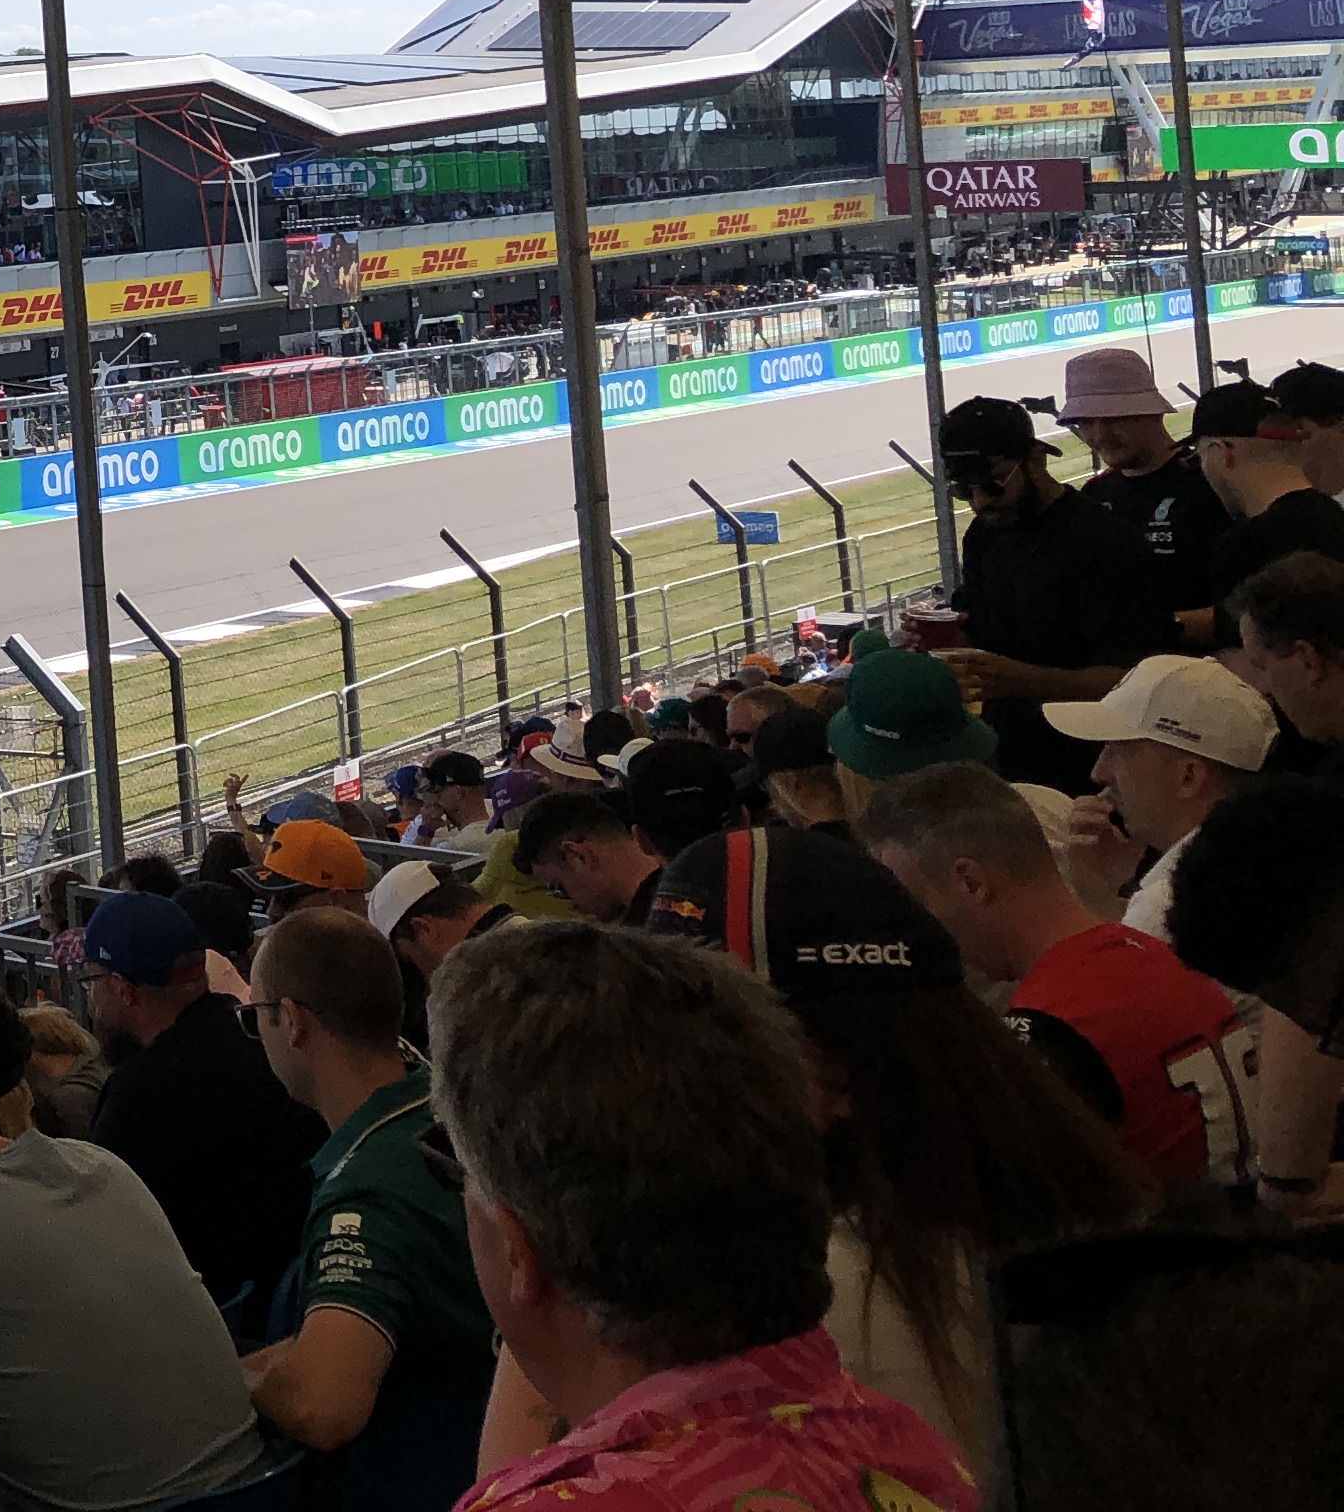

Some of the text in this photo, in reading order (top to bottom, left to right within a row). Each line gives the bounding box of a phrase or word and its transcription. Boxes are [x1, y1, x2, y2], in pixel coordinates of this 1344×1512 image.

[949, 14, 1023, 52] Vegas
[1182, 1, 1262, 38] Vegas
[926, 165, 1037, 196] QATAR
[954, 191, 1041, 209] AIRWAYS
[652, 221, 689, 244] DHL
[716, 213, 751, 236] DHL
[422, 247, 469, 274] DHL
[505, 238, 548, 263] DHL
[123, 280, 186, 311] DHL
[988, 319, 1038, 347] aramco
[1054, 309, 1099, 336] aramco
[50, 347, 59, 359] 27
[761, 351, 823, 385] aramco
[842, 339, 900, 371] aramco
[669, 365, 737, 399] aramco
[460, 393, 544, 433] aramco
[337, 411, 430, 452] aramco
[199, 429, 302, 474] aramco
[43, 448, 159, 498] armco
[823, 941, 912, 967] exact
